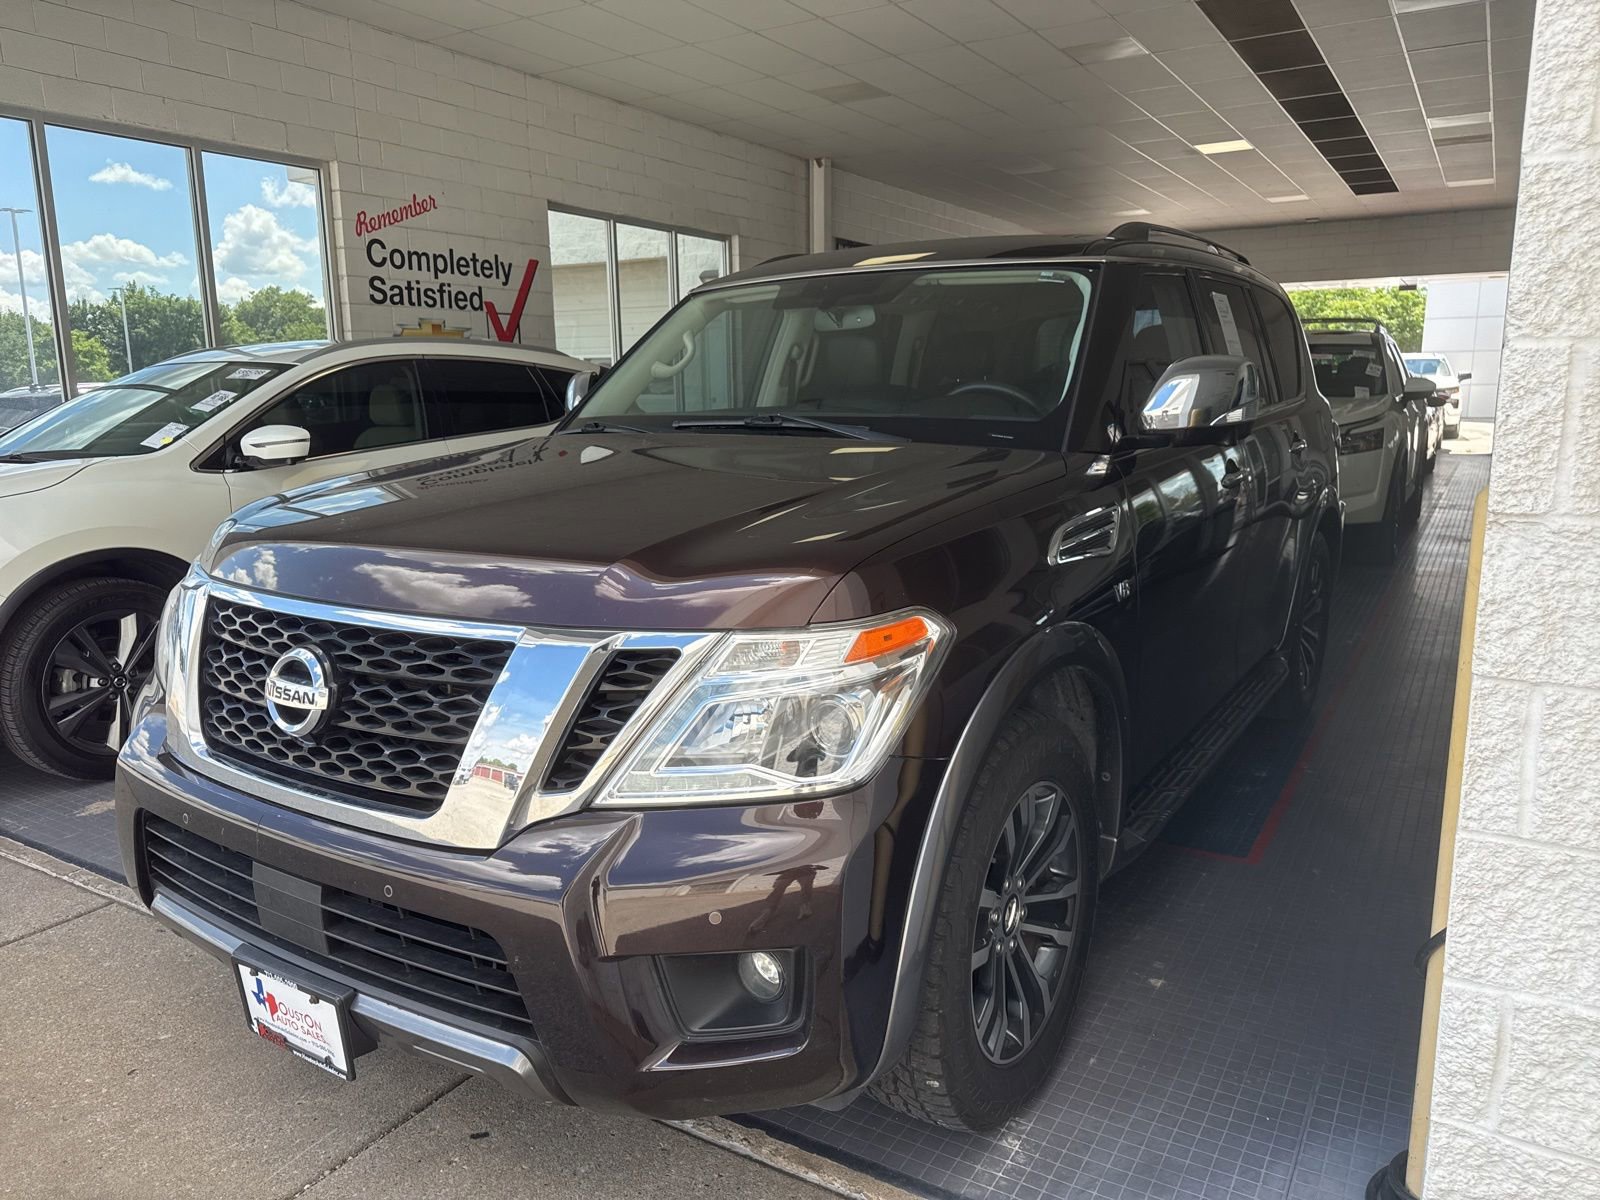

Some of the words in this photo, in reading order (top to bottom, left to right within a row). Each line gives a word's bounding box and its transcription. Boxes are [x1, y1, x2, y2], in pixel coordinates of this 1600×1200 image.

[356, 193, 438, 237] Remember
[366, 238, 513, 287] Completely
[368, 275, 484, 312] Satisfied
[266, 681, 316, 706] NISSAN
[276, 1015, 299, 1031] AUTO
